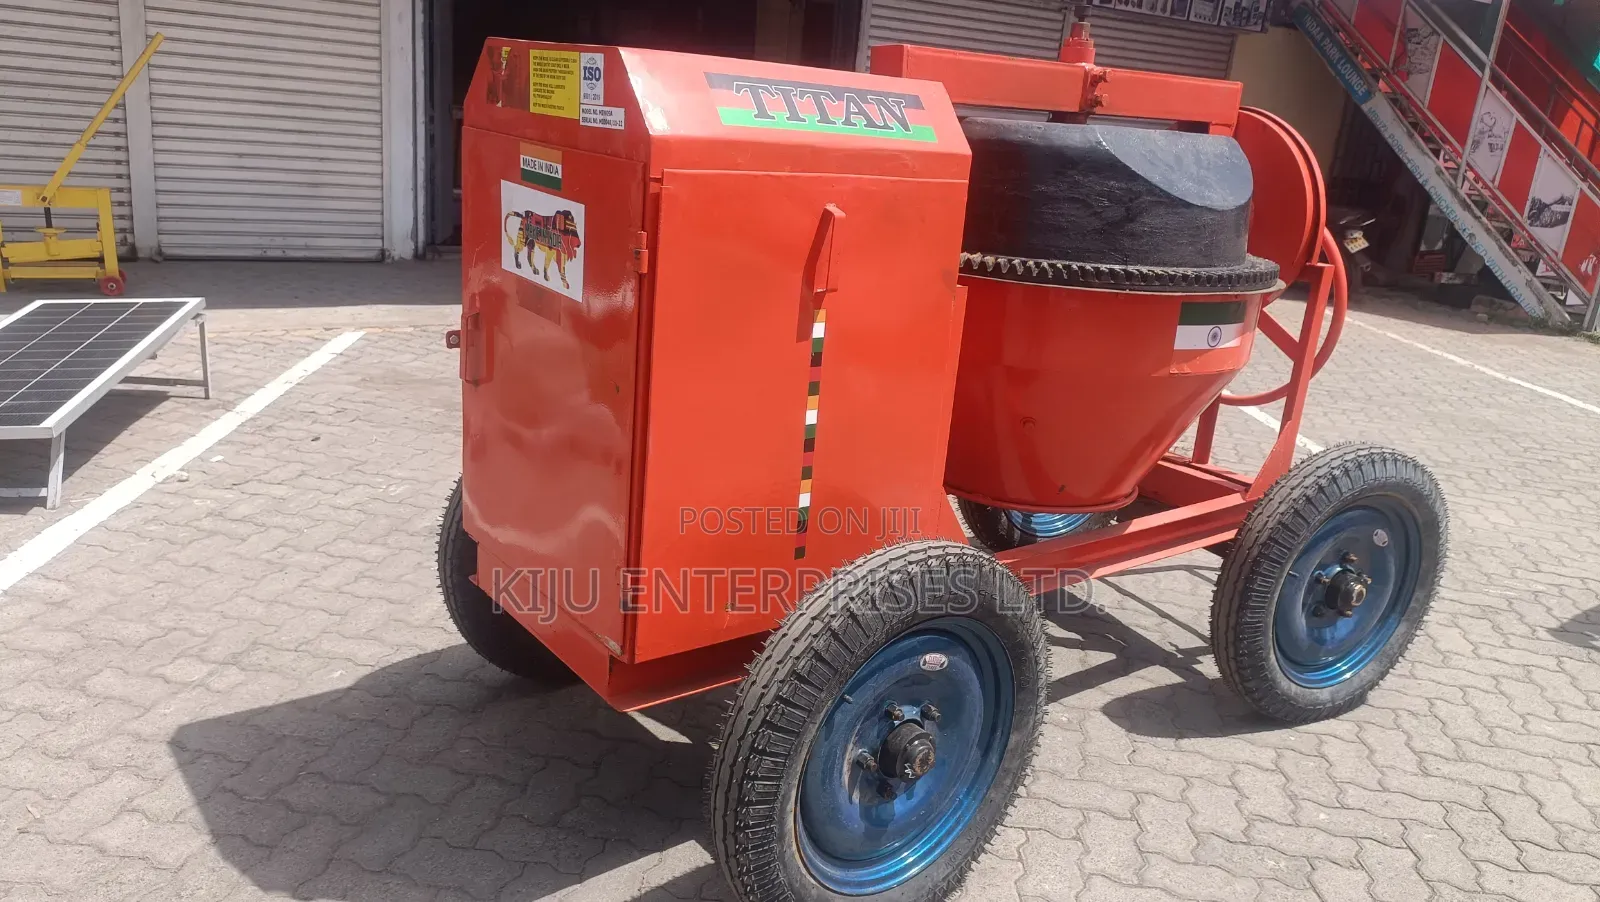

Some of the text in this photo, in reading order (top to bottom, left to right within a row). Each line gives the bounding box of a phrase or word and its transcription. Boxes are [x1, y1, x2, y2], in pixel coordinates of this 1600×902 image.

[582, 65, 602, 82] ISO
[1320, 37, 1343, 64] PARK
[1336, 58, 1368, 96] LOUNGE
[733, 81, 913, 134] TITAN
[522, 157, 560, 176] MADE IN INDIA
